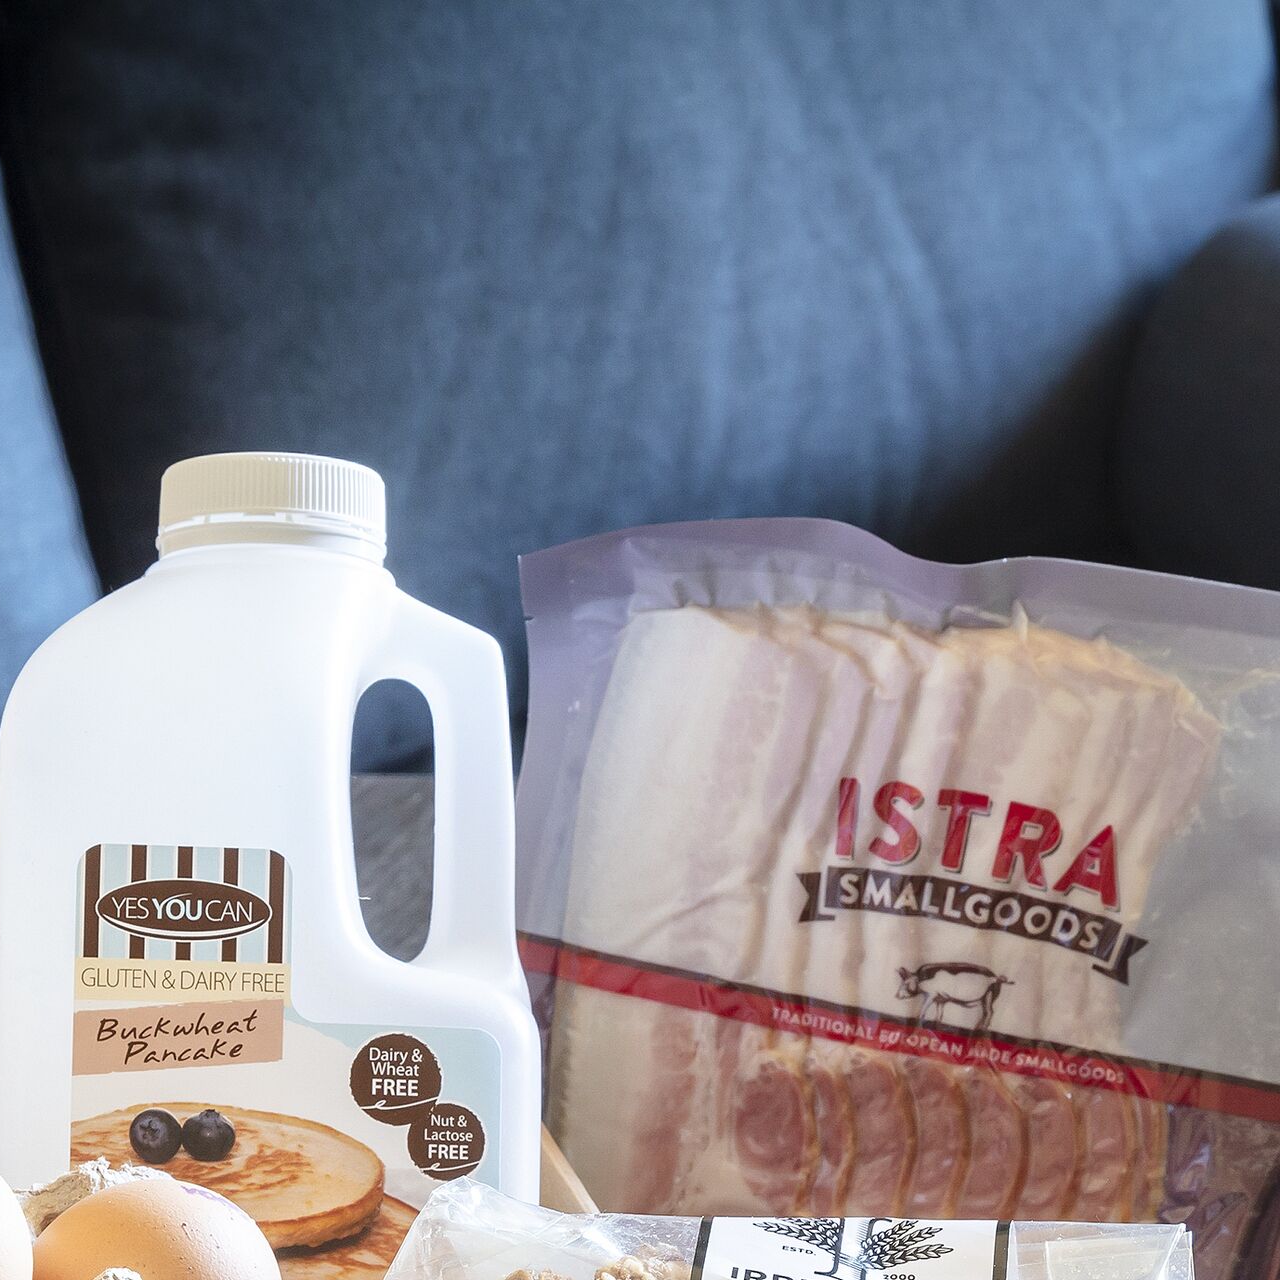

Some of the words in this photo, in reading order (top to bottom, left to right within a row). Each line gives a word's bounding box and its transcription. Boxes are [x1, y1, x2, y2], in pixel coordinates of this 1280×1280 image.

[833, 776, 1122, 911] ISTRA
[111, 896, 150, 920] YES
[152, 893, 202, 921] YOU
[205, 899, 253, 923] CAN
[839, 873, 1106, 952] SMALLGOODS
[81, 967, 157, 989] GLUTEN
[161, 970, 176, 990] &
[180, 970, 238, 992] DAIRY
[240, 972, 286, 994] FREE
[96, 1009, 258, 1043] Buckwheat
[124, 1039, 244, 1065] Pancake
[369, 1047, 409, 1065] Dairy
[411, 1048, 423, 1062] &
[772, 1006, 874, 1041] TRADITIONAL
[1014, 1053, 1125, 1085] SMALLGOODS
[371, 1061, 420, 1077] Wheat
[371, 1078, 419, 1097] FREE
[430, 1114, 455, 1127] Nut
[457, 1115, 468, 1127] &
[424, 1128, 473, 1142] Lactose
[427, 1143, 469, 1160] FREE
